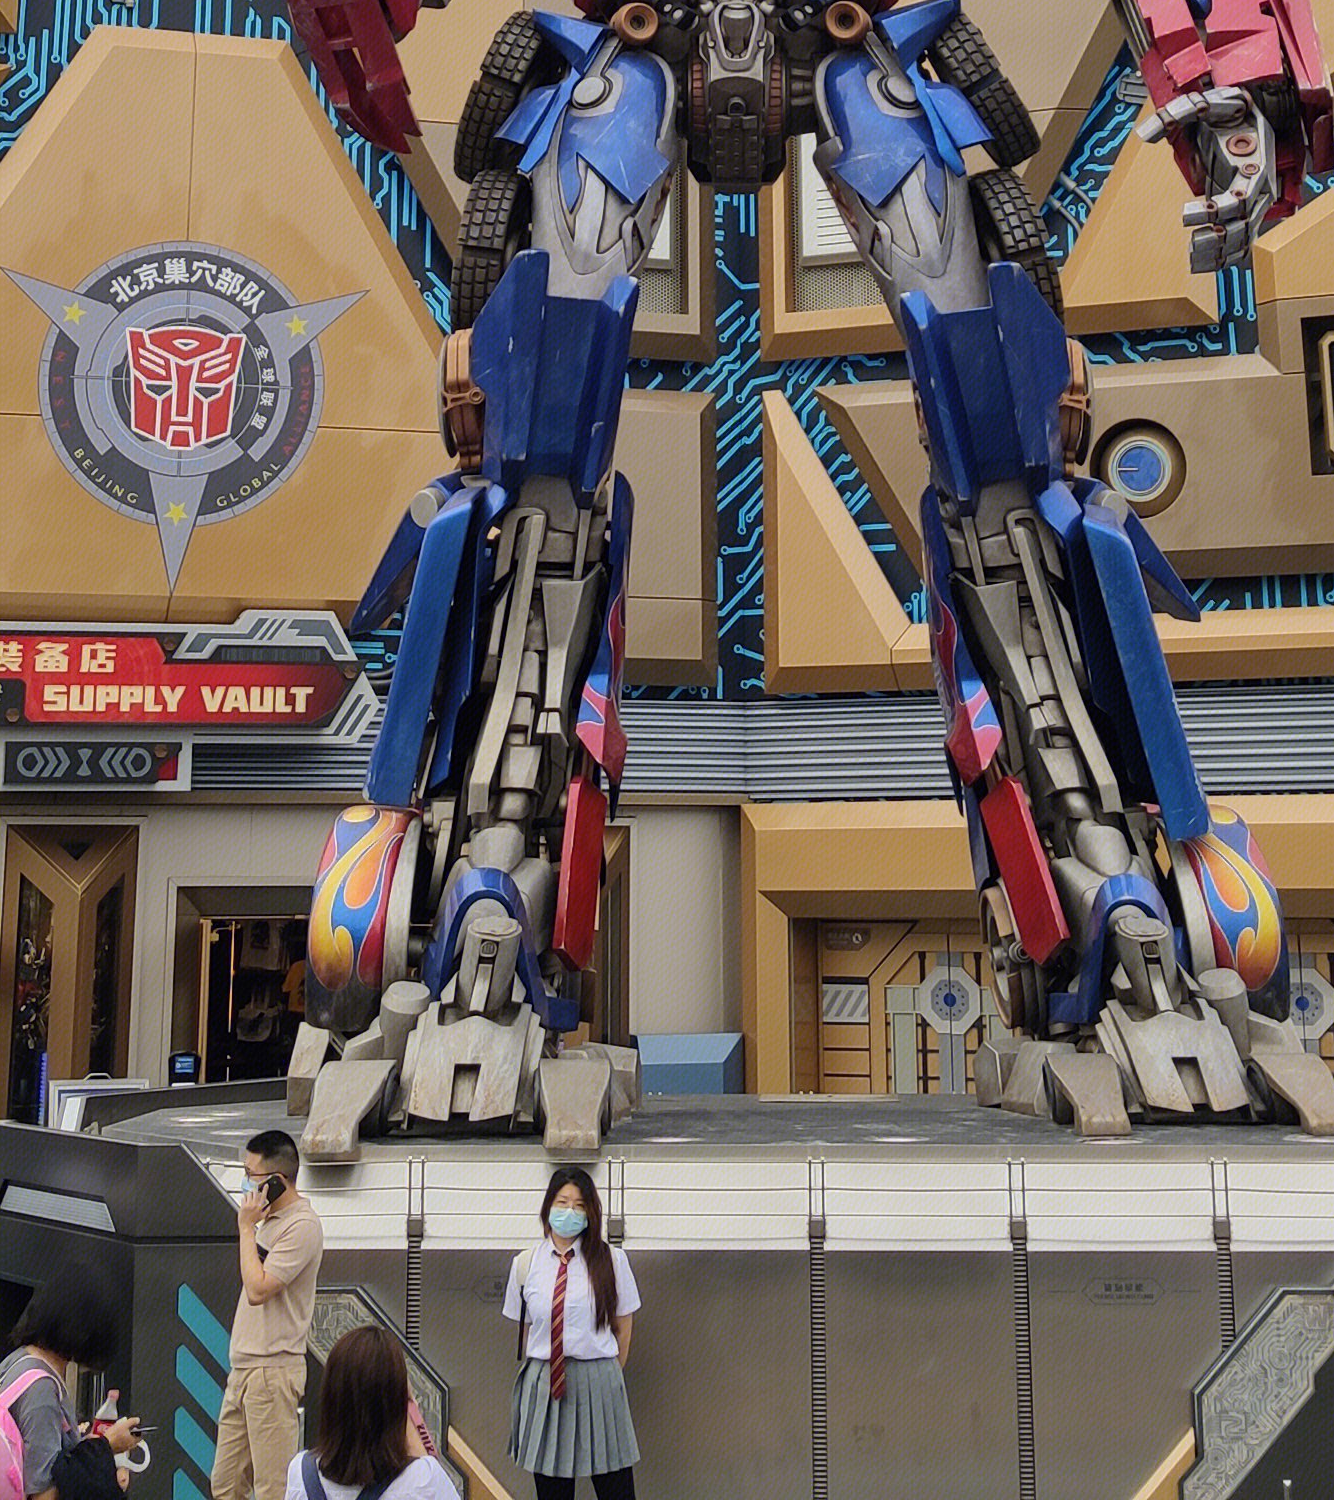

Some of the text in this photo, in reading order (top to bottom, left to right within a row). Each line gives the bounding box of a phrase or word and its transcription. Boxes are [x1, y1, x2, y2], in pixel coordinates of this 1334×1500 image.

[109, 257, 267, 315] 北京巢穴部队
[250, 344, 276, 430] 全球联盟
[73, 448, 140, 505] BEIJING
[216, 461, 282, 508] GLOBAL
[42, 684, 316, 714] SUPPLY VAULT
